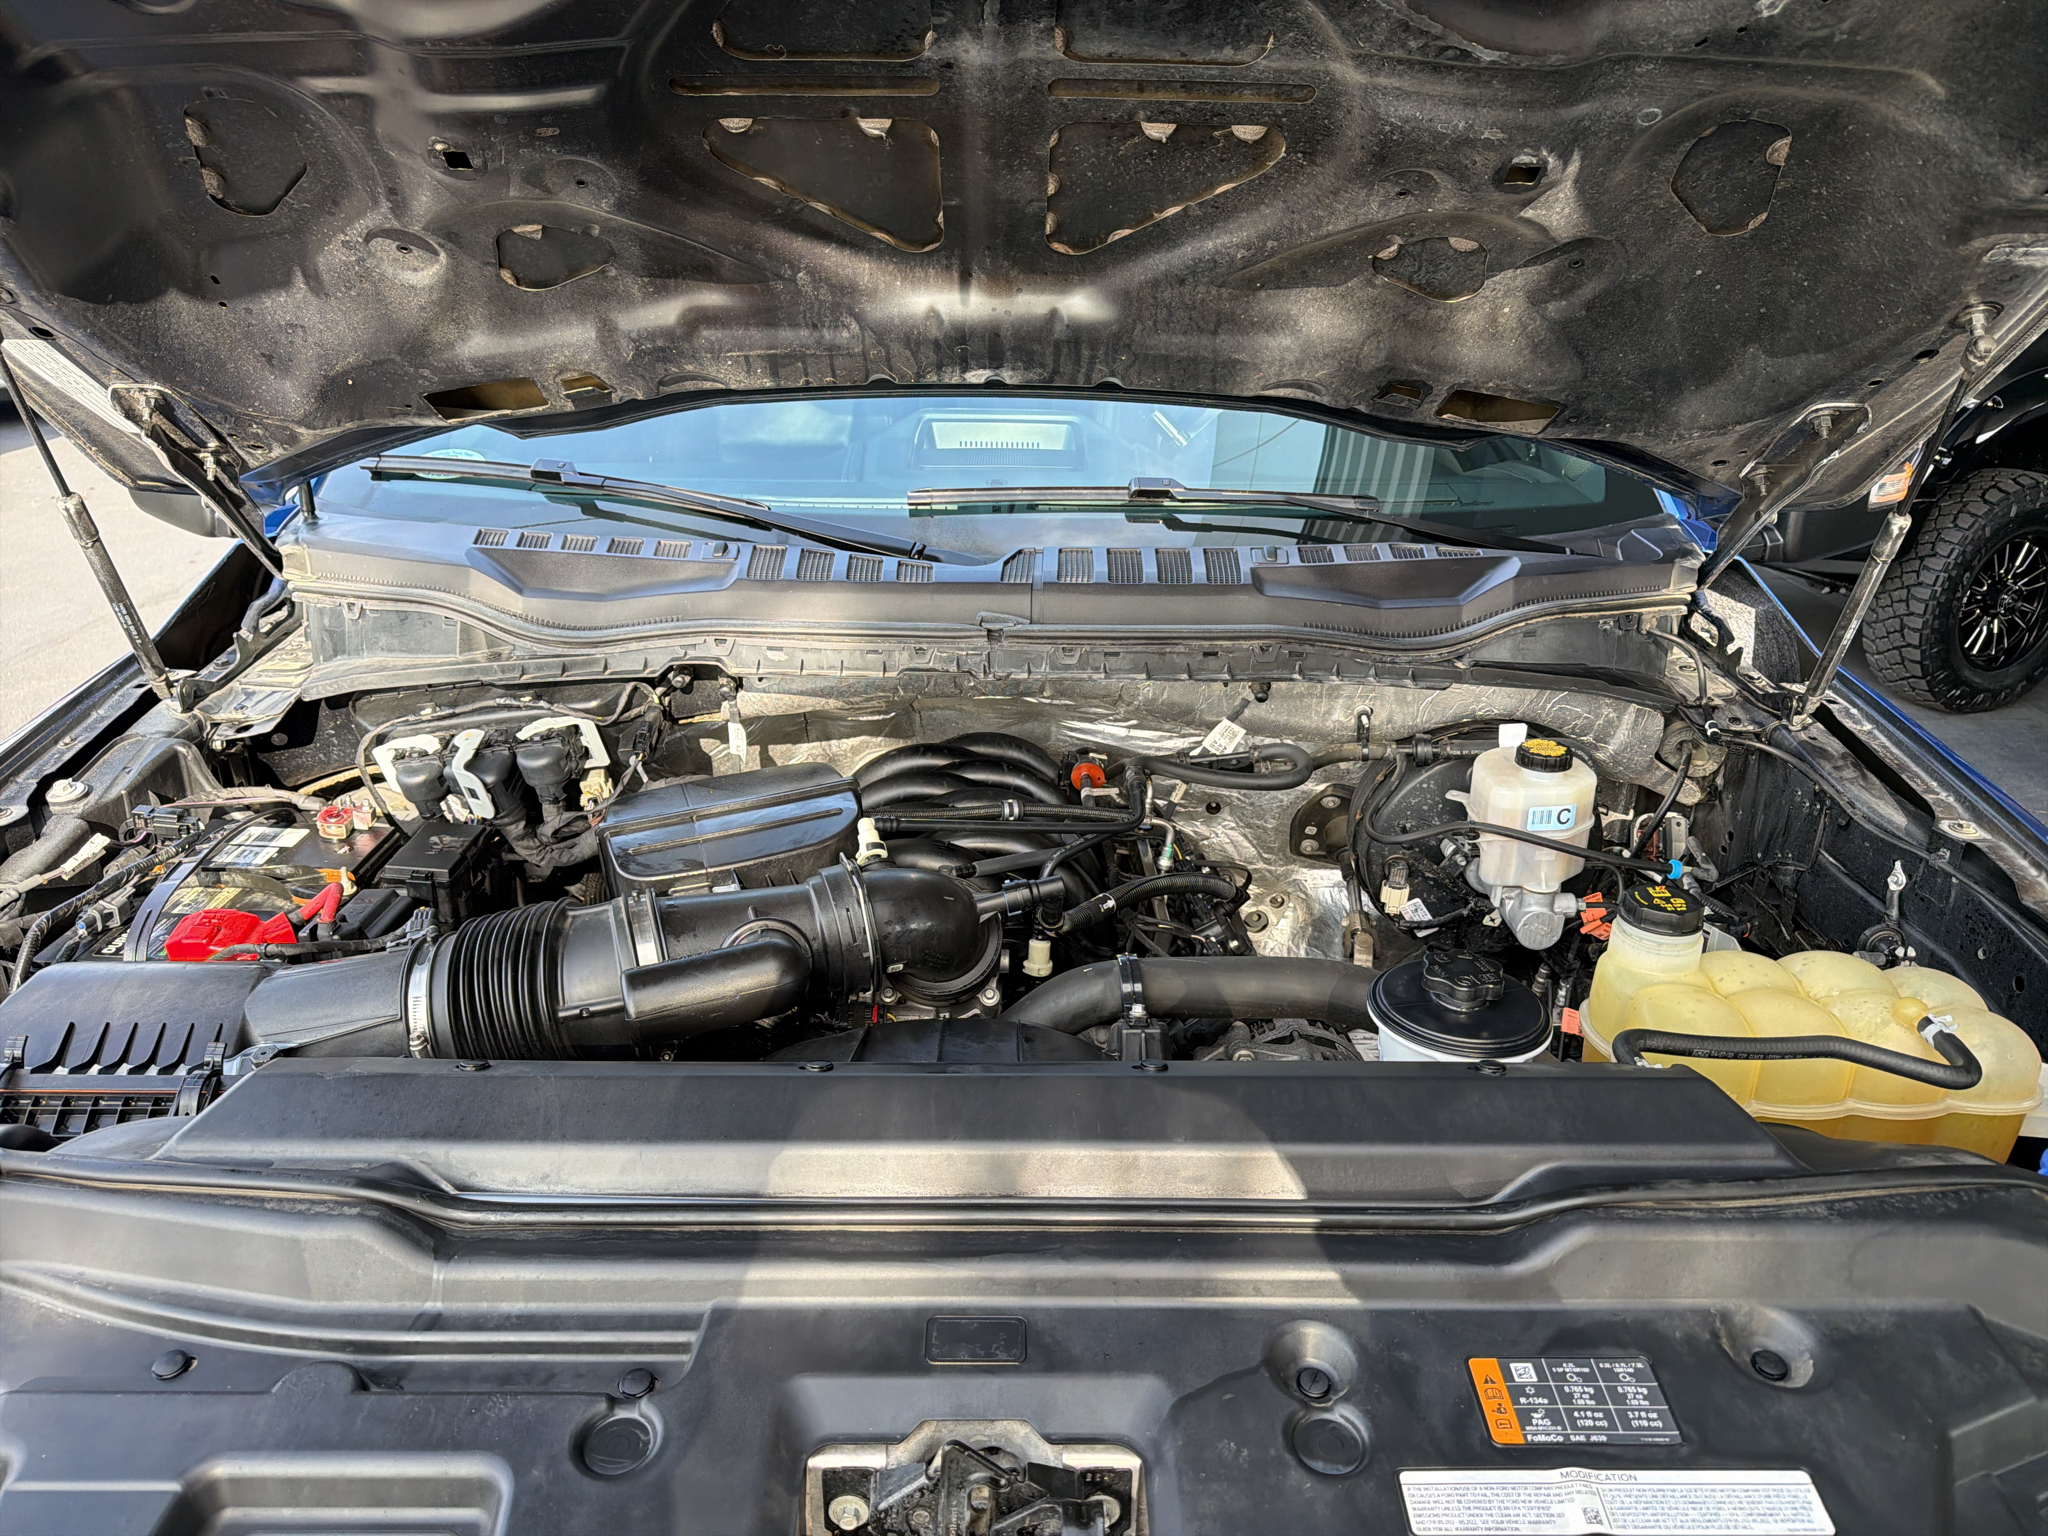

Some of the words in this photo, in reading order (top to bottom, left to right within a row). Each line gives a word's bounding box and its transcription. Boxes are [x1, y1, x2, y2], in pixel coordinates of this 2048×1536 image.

[1556, 807, 1571, 825] C
[1584, 1386, 1594, 1394] kg
[1637, 1386, 1648, 1395] kg
[1631, 1420, 1648, 1428] (110
[1649, 1420, 1663, 1429] cc)
[1560, 1470, 1638, 1482] MODIFICATION
